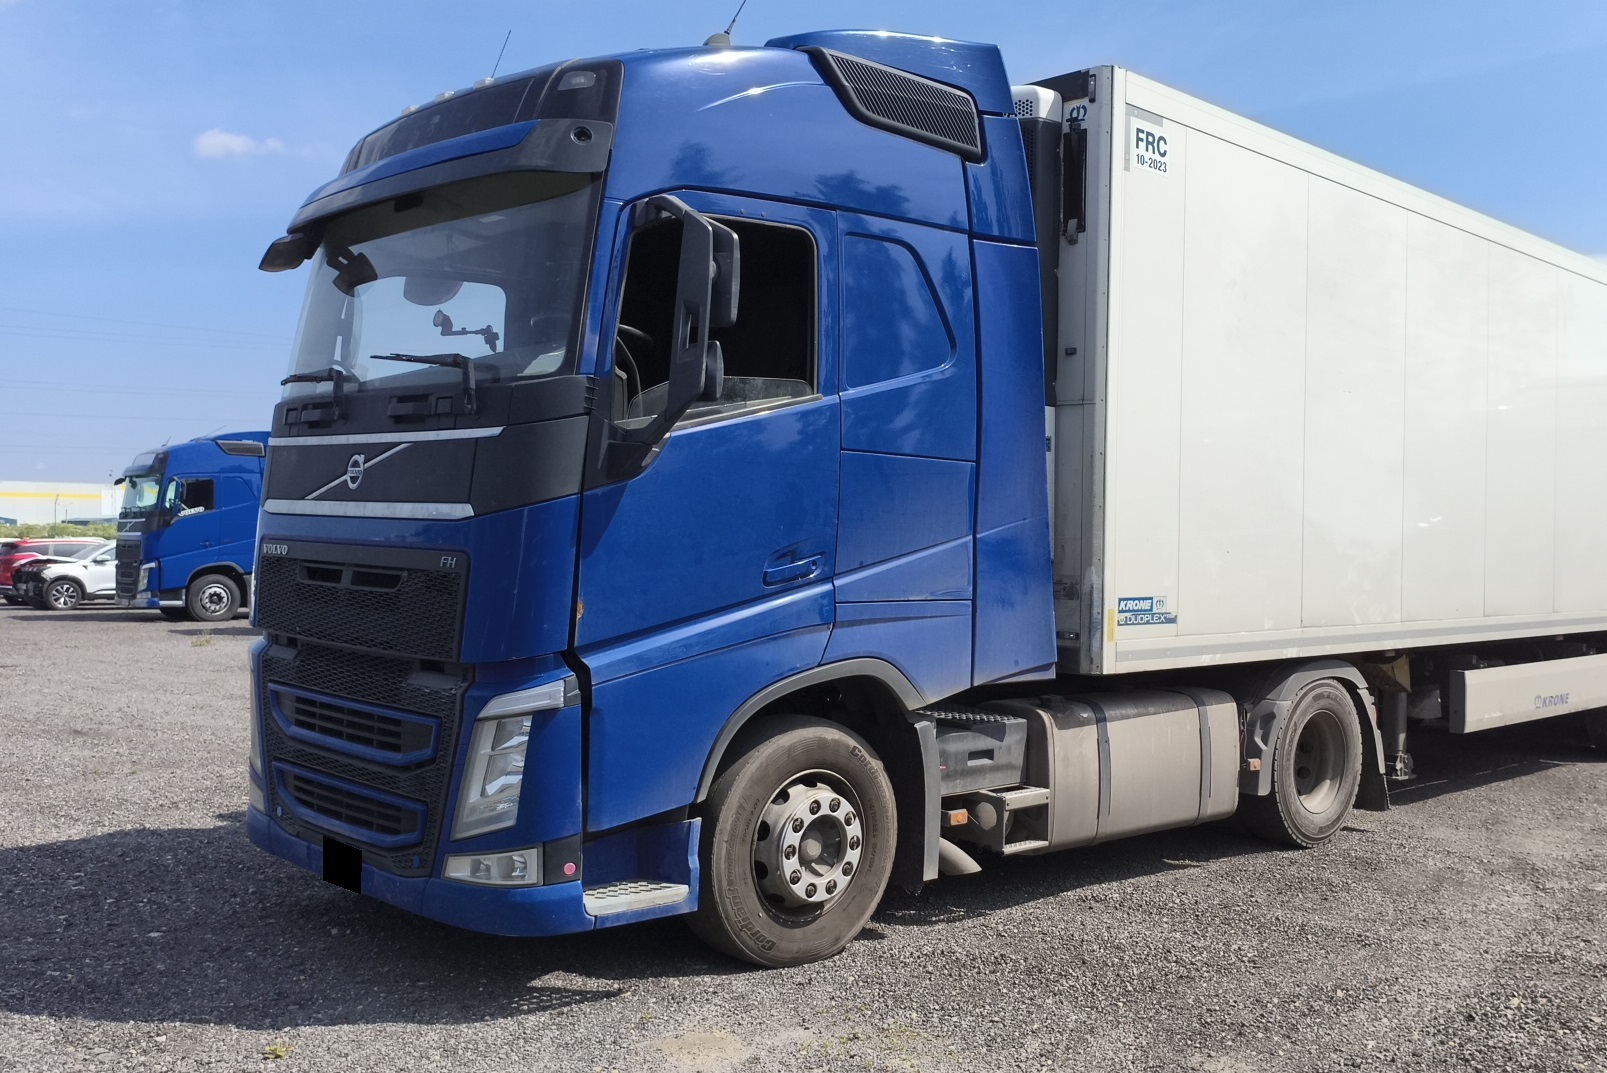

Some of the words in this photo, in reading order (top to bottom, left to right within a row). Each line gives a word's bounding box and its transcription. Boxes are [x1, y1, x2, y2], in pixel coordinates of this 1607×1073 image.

[1136, 127, 1168, 158] FRC
[1136, 153, 1167, 173] 10-2023
[263, 543, 288, 555] VOLVO
[440, 556, 457, 569] FH
[1119, 599, 1152, 611] KRONE
[1127, 613, 1166, 624] DUOPLEX
[1542, 692, 1570, 708] KRONE
[725, 886, 777, 953] Cordiant
